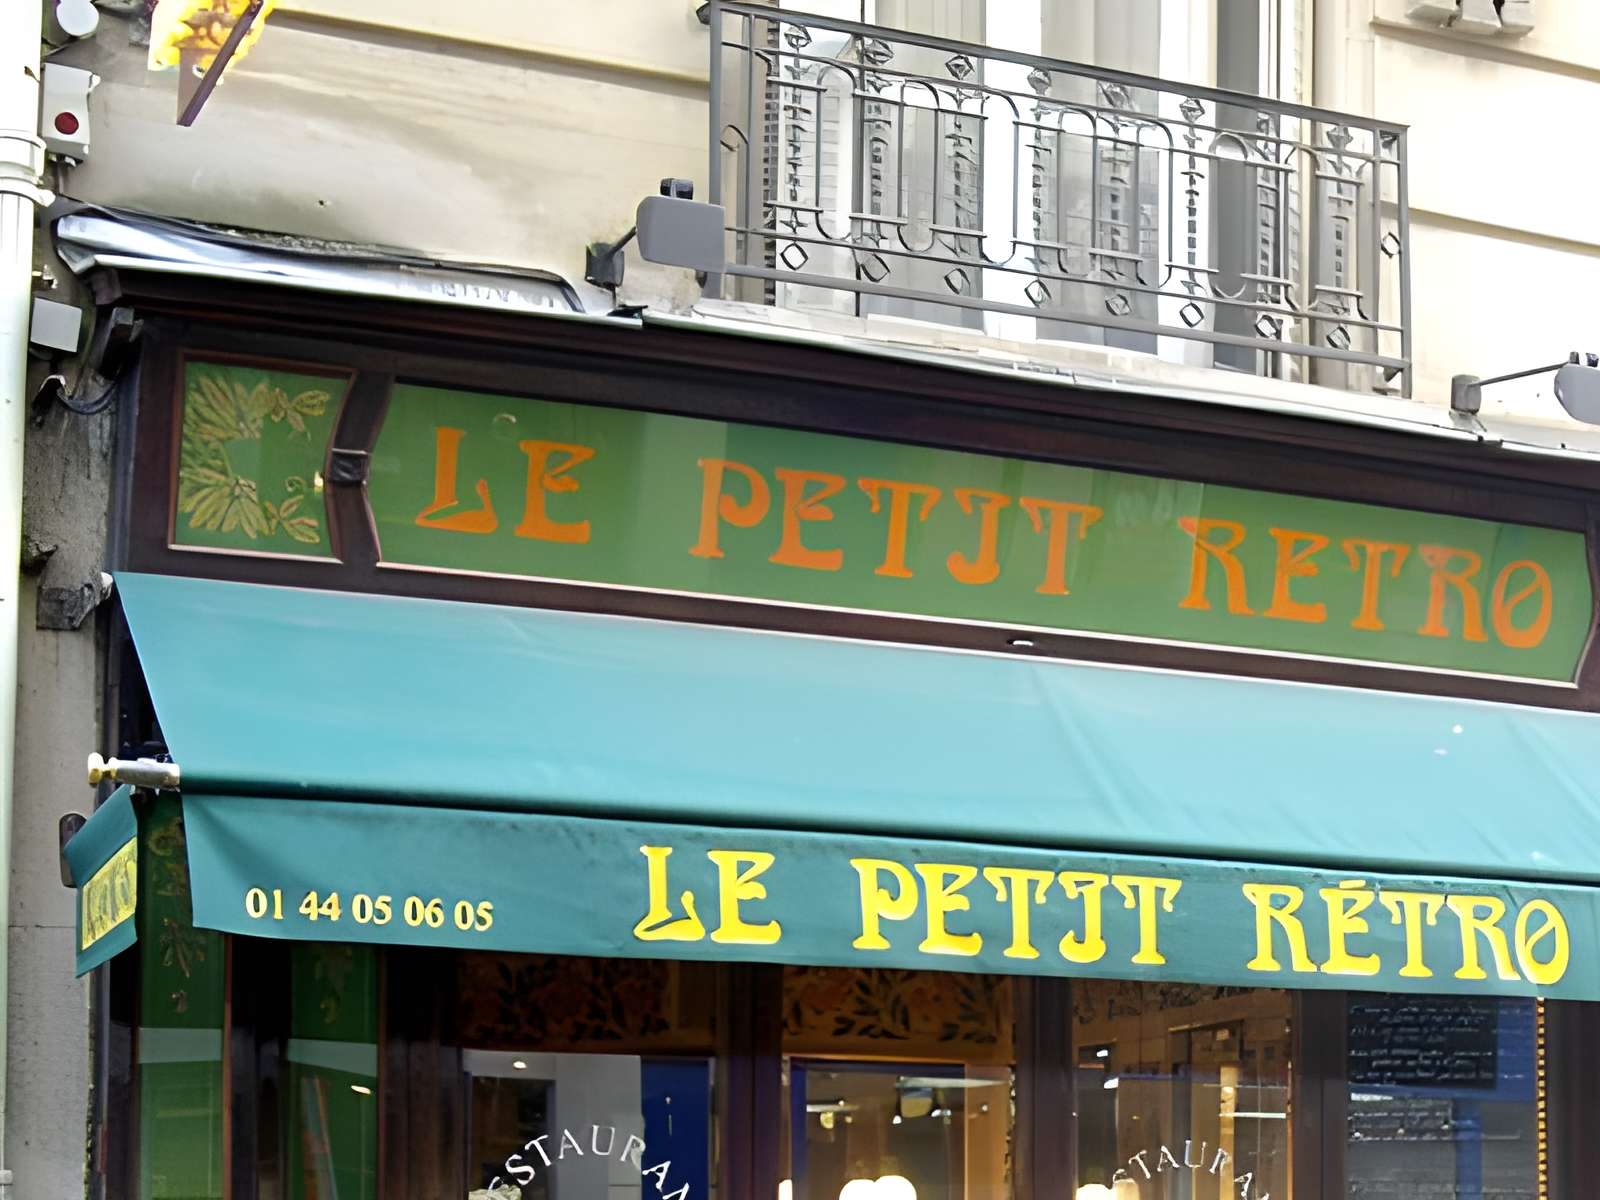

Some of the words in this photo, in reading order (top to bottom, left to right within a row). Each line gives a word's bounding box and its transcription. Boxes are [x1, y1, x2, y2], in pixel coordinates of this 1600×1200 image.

[414, 425, 596, 545] LE
[687, 457, 1103, 596] PETIT
[1177, 515, 1553, 649] RETRO
[245, 887, 284, 920] 01
[298, 890, 342, 922] 44
[351, 893, 393, 925] 05
[403, 895, 446, 929] 06
[453, 899, 495, 932] 05
[632, 844, 782, 945] LE
[849, 857, 1183, 965] PETIT
[1241, 879, 1570, 986] RÉTRO
